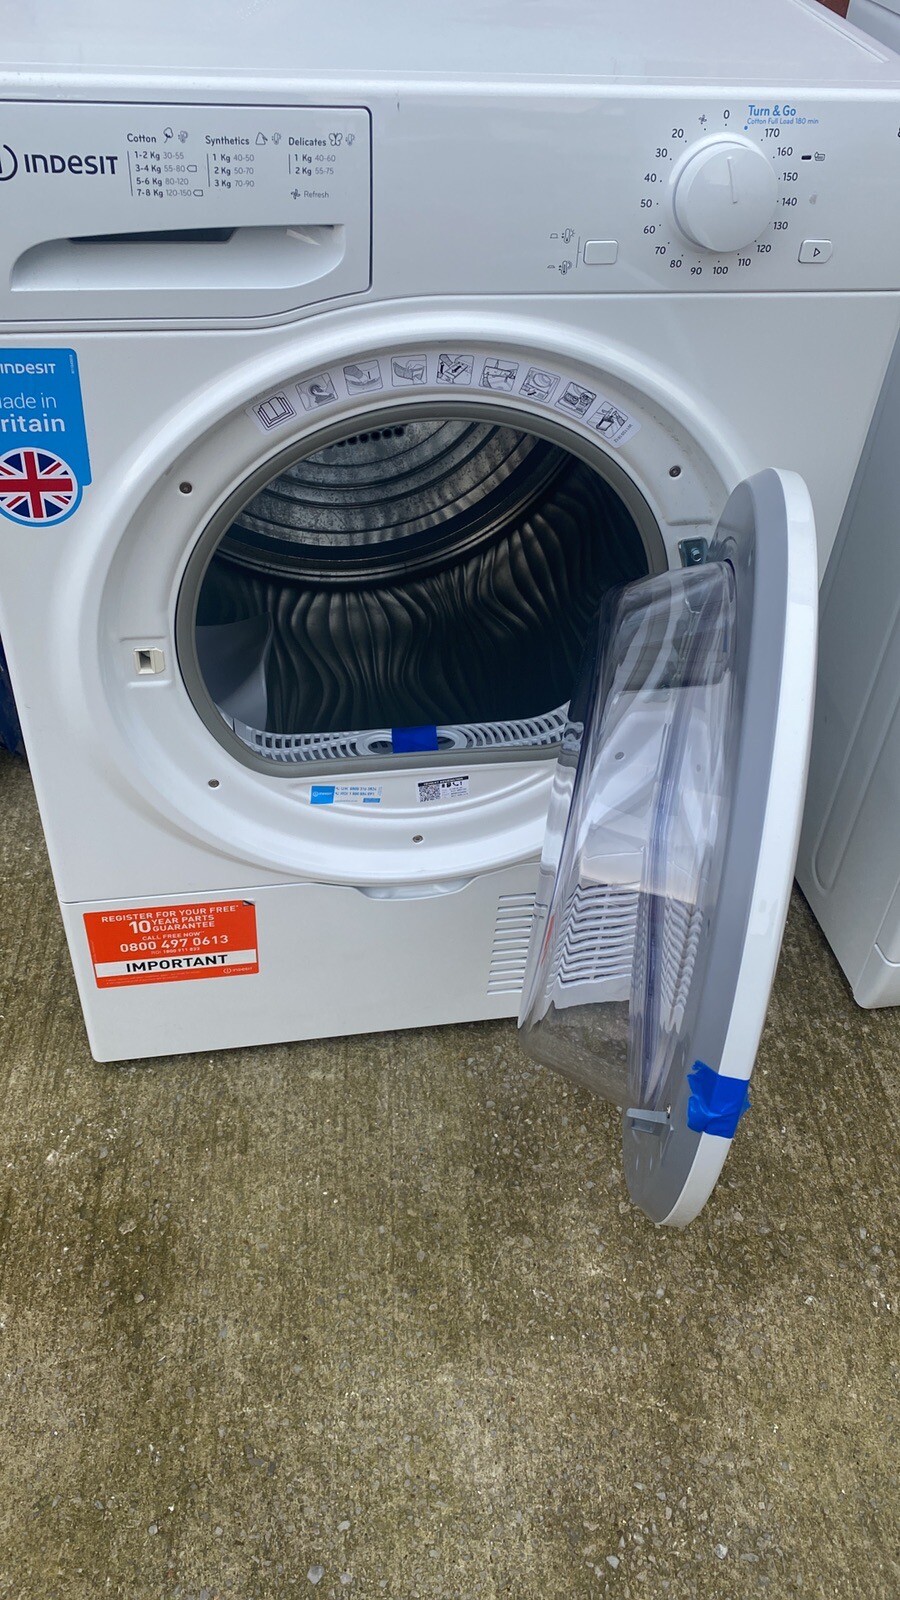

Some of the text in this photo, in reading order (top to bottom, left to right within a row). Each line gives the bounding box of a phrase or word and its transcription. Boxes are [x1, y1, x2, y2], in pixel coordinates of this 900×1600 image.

[748, 104, 796, 116] Turn & Go
[723, 110, 730, 120] 0
[672, 128, 684, 138] 20
[764, 128, 780, 138] 170
[126, 133, 157, 143] Cotton
[205, 135, 250, 147] Synthetics
[288, 136, 326, 146] Delicates
[134, 151, 184, 161] 1-2 Kg 30-55
[655, 148, 668, 158] 30
[777, 147, 793, 156] 160
[220, 154, 230, 163] Kg
[302, 154, 312, 163] Kg
[151, 165, 161, 174] Kg
[221, 167, 231, 176] Kg
[302, 168, 312, 176] Kg
[644, 173, 656, 183] 40
[782, 172, 798, 182] 150
[152, 178, 162, 187] Kg
[222, 180, 231, 189] Kg
[153, 189, 163, 198] Kg
[640, 199, 652, 208] 50
[782, 197, 797, 206] 140
[643, 225, 655, 234] 60
[773, 221, 788, 230] 130
[655, 246, 666, 255] 70
[757, 244, 772, 253] 120
[670, 260, 682, 268] 80
[738, 258, 751, 266] 110
[690, 267, 702, 275] 90
[712, 266, 728, 275] 100
[0, 392, 57, 409] ade in
[0, 413, 66, 433] ritain
[101, 913, 155, 923] REGISTER
[156, 910, 176, 918] FOR
[179, 907, 206, 916] YOUR
[128, 920, 151, 934] 10
[182, 914, 214, 922] PARTS
[152, 921, 215, 932] GUARANTEE
[120, 934, 228, 953] 0800 497 0613
[126, 954, 228, 973] IMPORTANT
